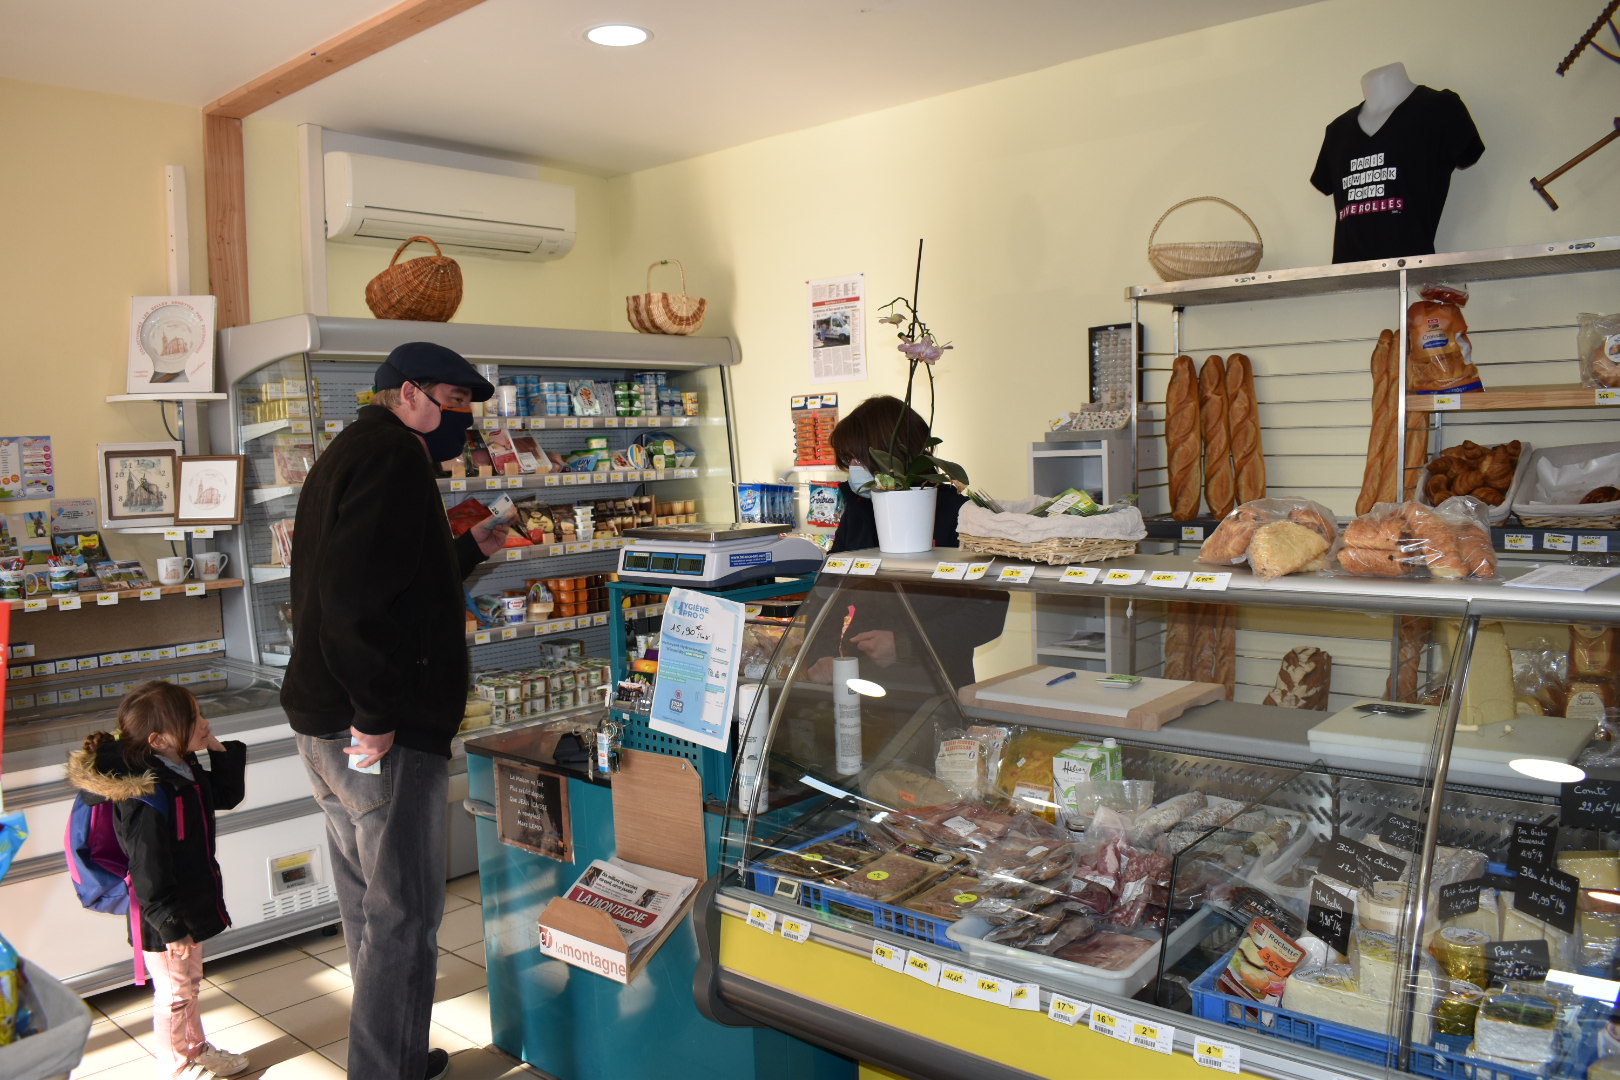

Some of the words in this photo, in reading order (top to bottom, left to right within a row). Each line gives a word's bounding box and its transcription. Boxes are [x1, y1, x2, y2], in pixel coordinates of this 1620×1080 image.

[1351, 153, 1384, 171] PARIS
[1348, 184, 1384, 200] TOKYO
[491, 507, 499, 515] 20
[672, 599, 709, 616] HYGIÈNE
[683, 611, 698, 620] PRO
[1574, 785, 1611, 796] Comté
[576, 891, 590, 905] LA
[589, 897, 648, 924] MONTAGNE
[1268, 933, 1299, 958] Raclette
[563, 943, 626, 976] montagne
